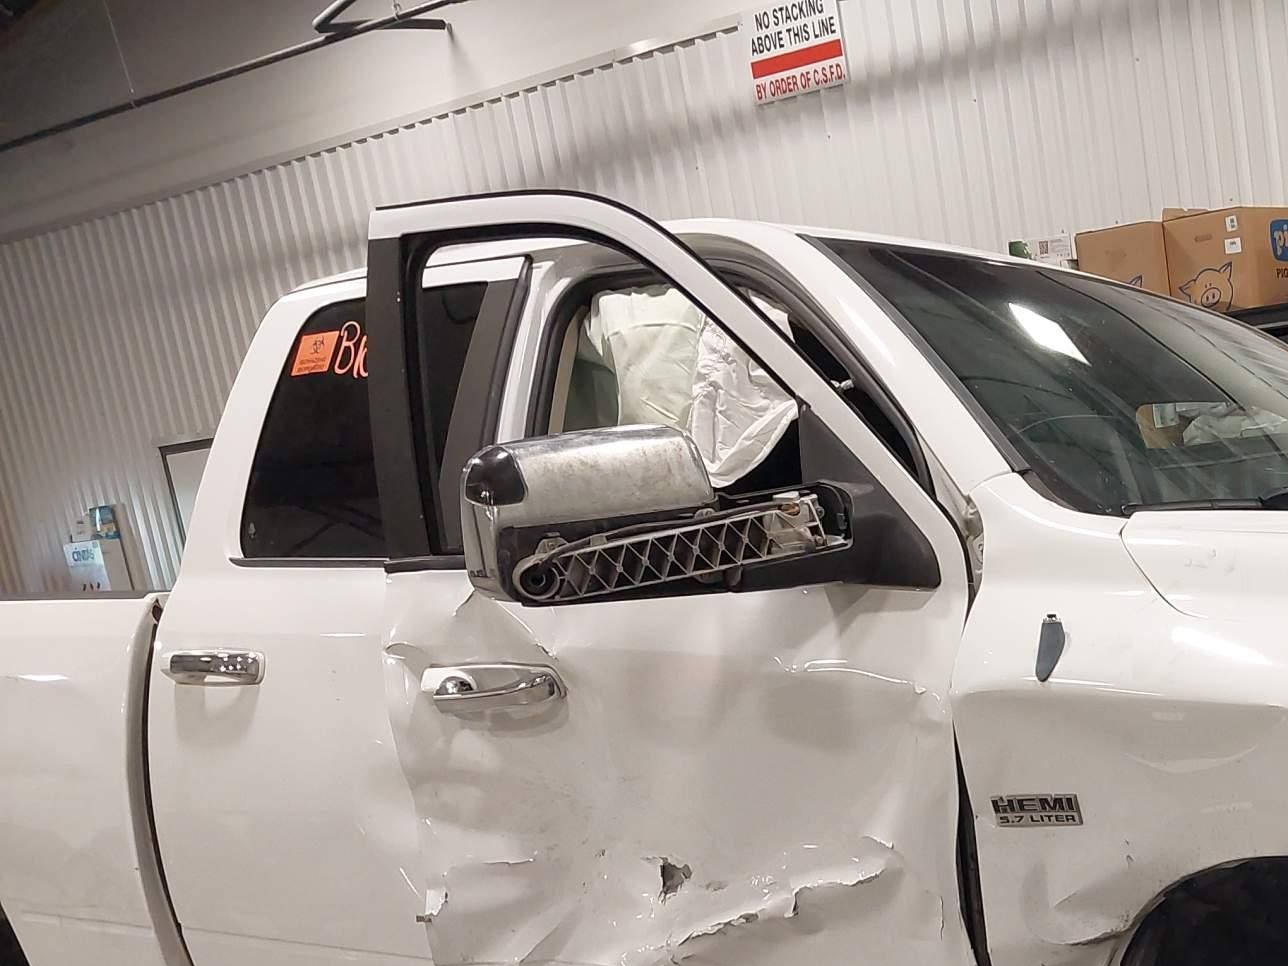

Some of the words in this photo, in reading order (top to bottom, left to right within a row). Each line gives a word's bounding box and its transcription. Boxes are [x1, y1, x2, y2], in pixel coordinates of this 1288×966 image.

[755, 11, 770, 31] NO
[772, 0, 824, 26] STACKING
[751, 30, 785, 56] ABOVE
[786, 23, 810, 46] THIS
[812, 16, 836, 39] LINE
[756, 82, 767, 101] BY
[769, 75, 799, 97] ORDER
[800, 71, 811, 89] OF
[813, 63, 846, 86] C.S.F.D.
[1276, 267, 1288, 279] PIG
[990, 795, 1077, 814] HEMI
[1000, 816, 1024, 824] 5.7
[1030, 814, 1077, 823] LITER
